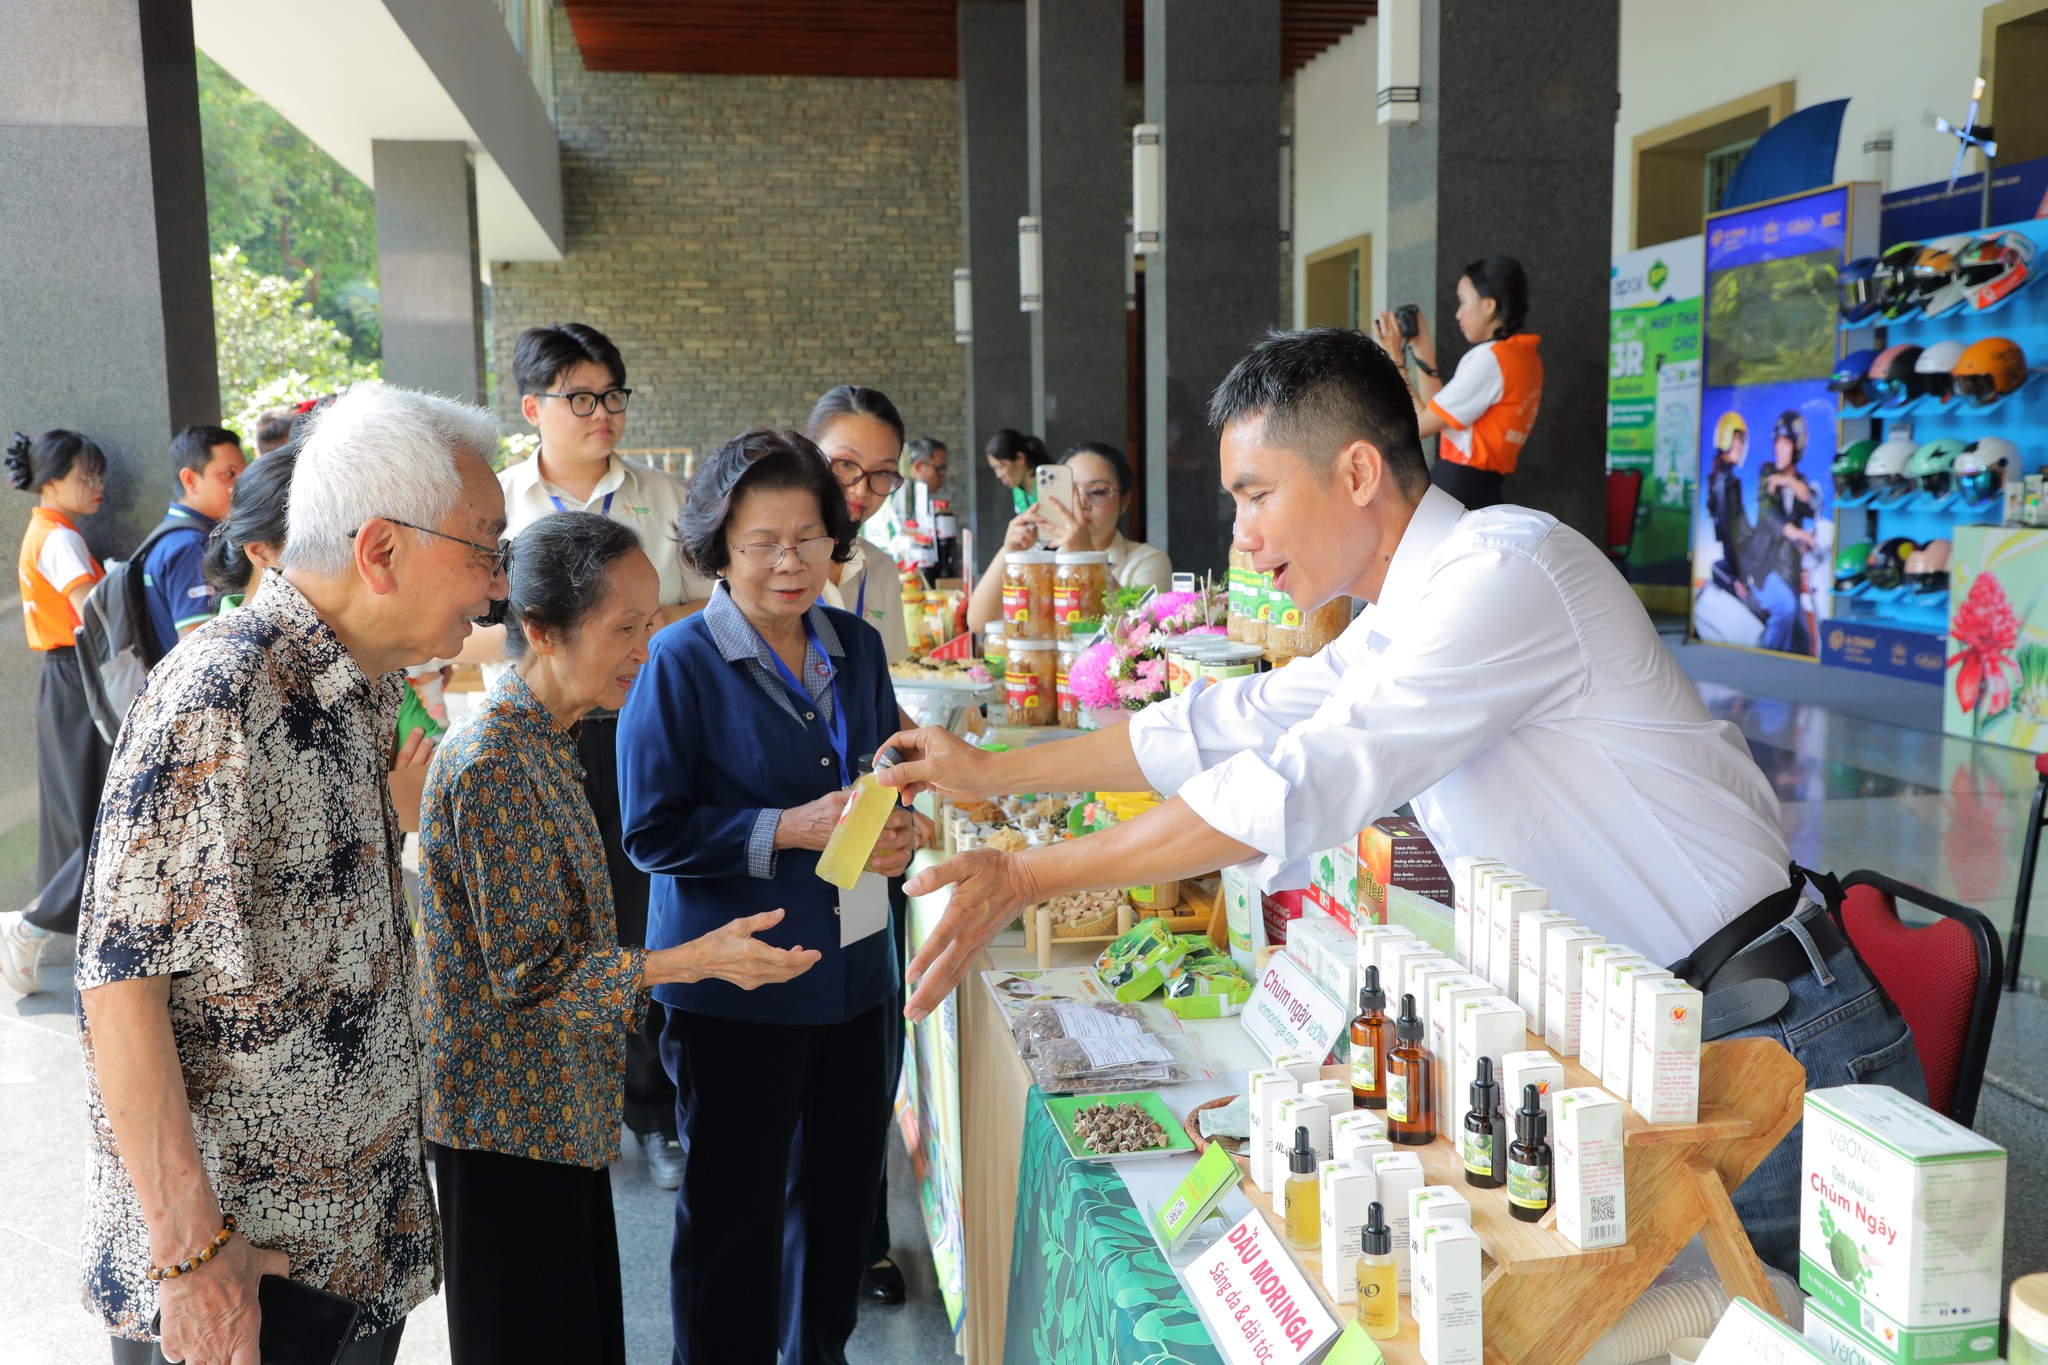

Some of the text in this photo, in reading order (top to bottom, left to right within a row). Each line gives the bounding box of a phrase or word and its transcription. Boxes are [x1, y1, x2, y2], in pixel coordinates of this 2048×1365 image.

[1610, 341, 1645, 379] 3R
[1273, 914, 1286, 929] KHÔ
[1274, 901, 1291, 919] LONG
[1258, 1001, 1299, 1050] vnmoringa.com
[1264, 969, 1291, 1006] Chùm
[1288, 997, 1312, 1030] ngây
[1811, 1172, 1850, 1213] Chùm
[1855, 1201, 1897, 1245] Ngây
[1210, 1262, 1273, 1365] Sáng da & dài tóc
[1228, 1223, 1314, 1352] DẦU MORINGA
